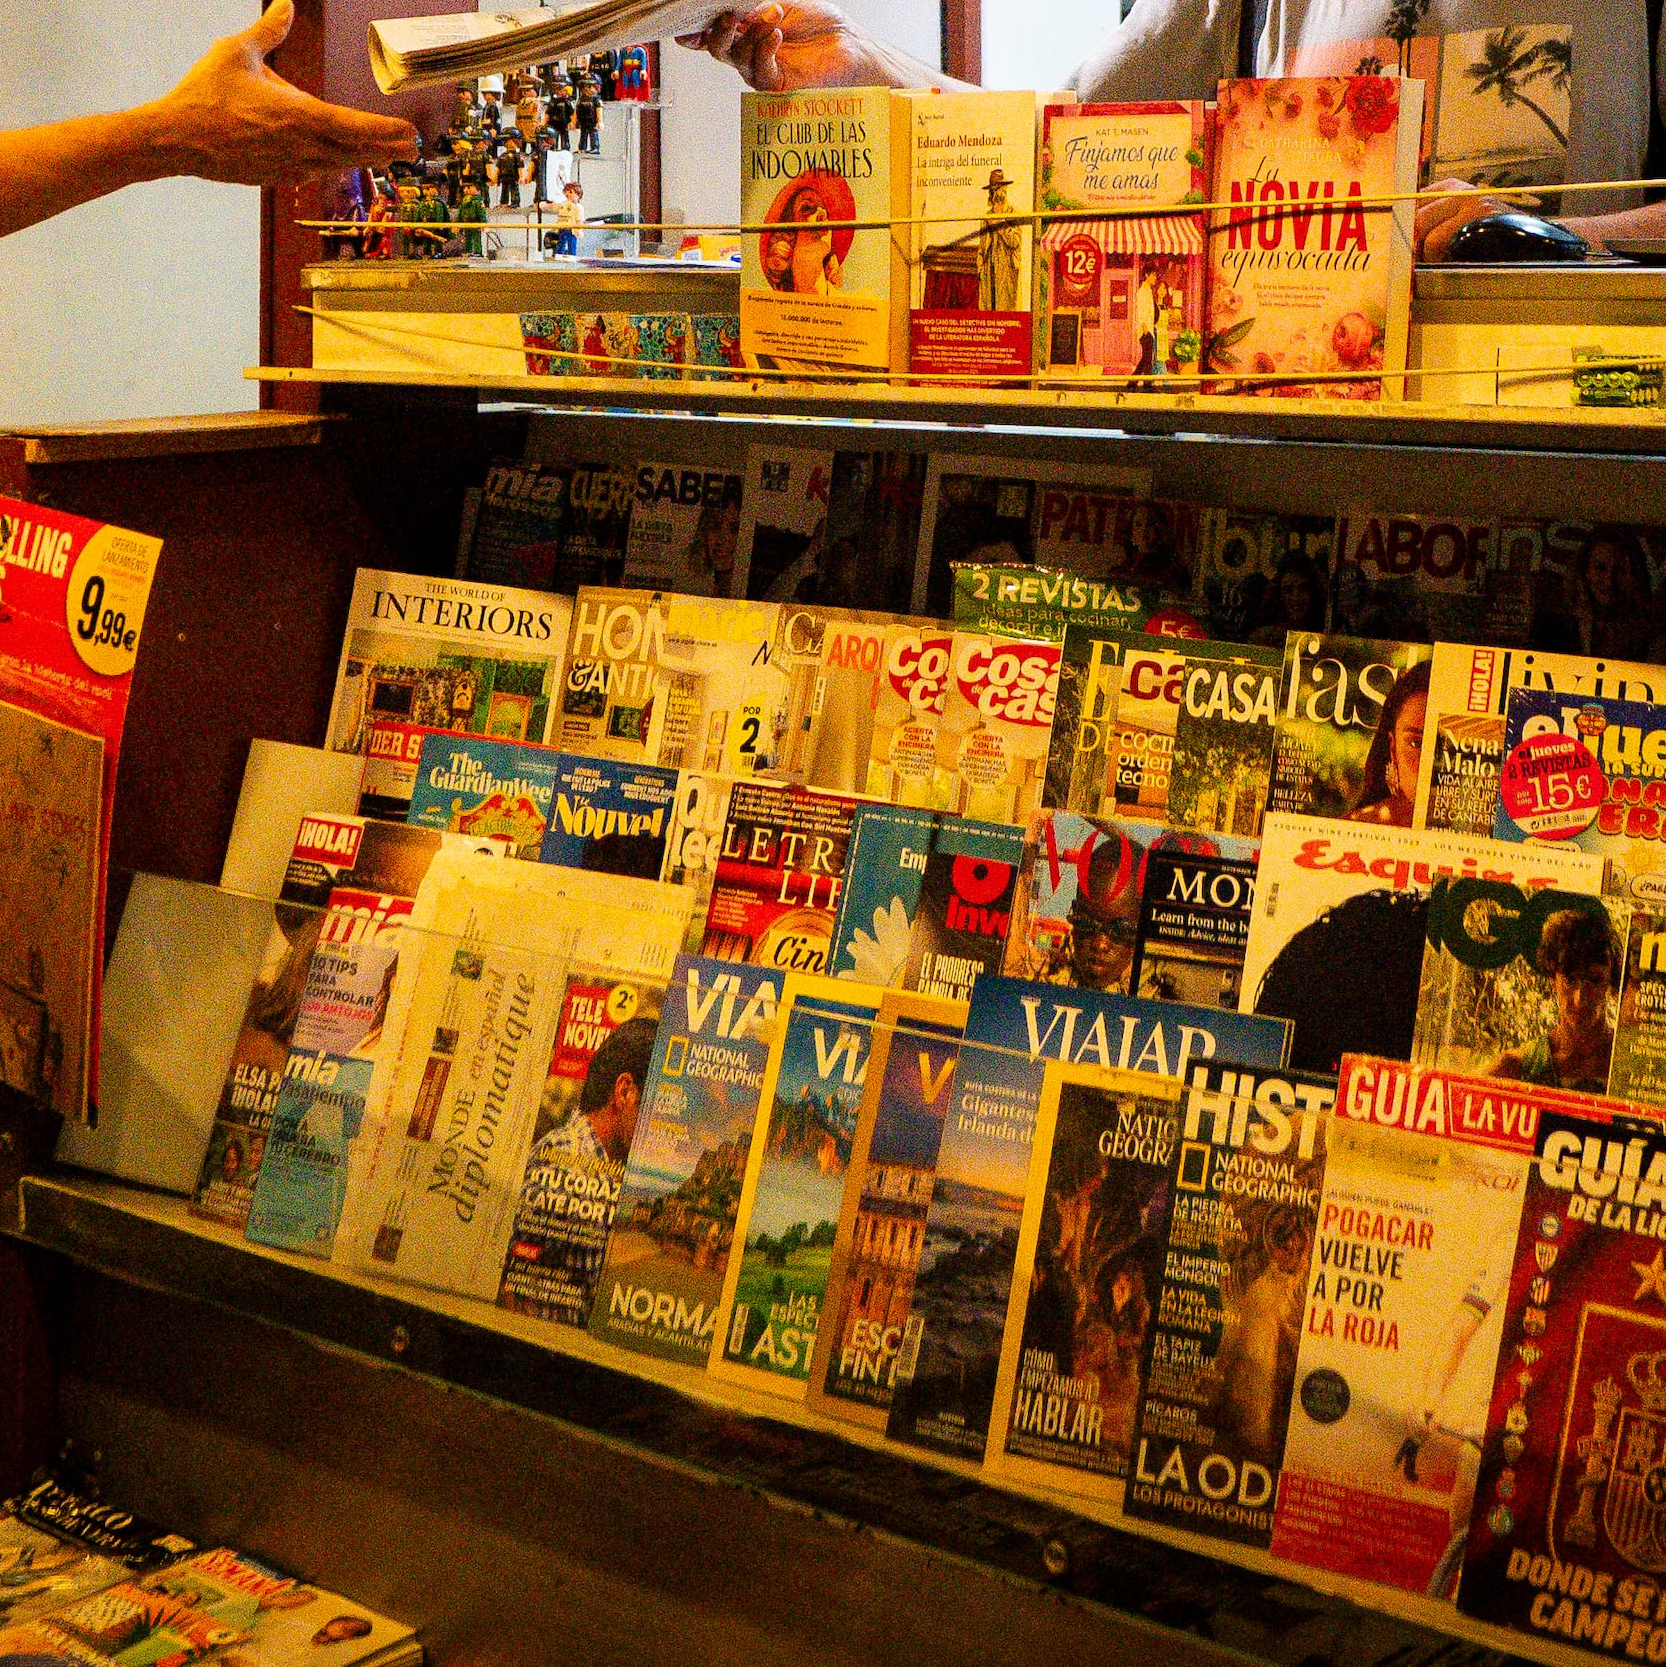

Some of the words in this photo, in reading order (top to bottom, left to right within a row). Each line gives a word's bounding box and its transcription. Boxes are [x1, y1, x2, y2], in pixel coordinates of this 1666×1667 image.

[757, 123, 771, 145] EL
[776, 124, 812, 144] CLUB
[817, 122, 835, 143] DE
[840, 121, 866, 143] LAS
[917, 136, 956, 149] Eduardo
[958, 134, 1002, 147] Mendoza
[751, 147, 873, 180] INDOMABLES
[957, 155, 969, 167] del
[971, 153, 1002, 166] funeral
[1064, 136, 1145, 172] Finjamos
[1147, 146, 1178, 170] que
[1082, 175, 1111, 191] me
[1114, 170, 1159, 191] amas
[1228, 181, 1369, 252] NOVIA
[1221, 246, 1372, 288] equivocada
[426, 582, 451, 595] THE
[452, 586, 485, 601] WORLD
[487, 591, 506, 602] OF
[972, 573, 990, 601] 2
[997, 573, 1142, 613] REVISTAS
[77, 575, 136, 653] 9,99€
[371, 591, 554, 642] INTERIORS
[1027, 609, 1065, 627] para
[1069, 610, 1132, 632] cocinar,
[1467, 649, 1495, 713] ¡HOLA!
[1185, 667, 1277, 727] CASA
[370, 731, 402, 758] DER
[740, 718, 761, 754] 2
[1448, 730, 1499, 756] Nena
[449, 751, 483, 774] The
[1115, 765, 1169, 790] tecno
[1442, 753, 1496, 780] Malo
[1521, 753, 1592, 775] REVISTAS
[1438, 773, 1461, 788] VIDA
[550, 793, 664, 840] Nouvel
[1434, 808, 1447, 820] DE
[1435, 797, 1451, 809] EN
[1452, 799, 1468, 812] SU
[298, 819, 359, 856] ¡HOLA!
[1151, 907, 1185, 926] Learn
[1187, 913, 1215, 931] from
[1217, 918, 1237, 933] the
[329, 958, 358, 976] TIPS
[306, 986, 374, 1007] CONTROLAR
[571, 994, 606, 1025] TELE
[1019, 995, 1217, 1080] VIAJAR
[284, 1050, 341, 1086] mia
[690, 1043, 750, 1068] NATIONAL
[685, 1060, 764, 1091] GEOGRAPHIC
[447, 970, 537, 1226] diplomatique
[1344, 1058, 1447, 1137] GUÍA
[958, 1113, 1017, 1143] Irlanda
[1215, 1152, 1297, 1183] NATIONAL
[526, 1191, 568, 1216] LATE
[570, 1199, 605, 1223] POR
[1174, 1194, 1190, 1208] LA
[1192, 1195, 1236, 1214] PIEDRA
[1210, 1173, 1320, 1212] GEOGRAPHIC
[1172, 1207, 1188, 1221] DE
[1322, 1203, 1436, 1252] POGACAR
[1566, 1195, 1599, 1226] DE
[1599, 1200, 1633, 1231] LA
[1180, 1255, 1232, 1275] IMPERIO
[1319, 1236, 1407, 1281] VUELVE
[1164, 1267, 1220, 1288] MONGOL
[1311, 1275, 1328, 1300] A
[1334, 1278, 1386, 1313] POR
[1307, 1305, 1335, 1337] LA
[1342, 1315, 1402, 1352] ROJA
[1023, 1346, 1054, 1371] CÓMO
[1013, 1389, 1105, 1447] HABLAR
[1135, 1436, 1190, 1494] LA
[1198, 1453, 1274, 1508] OD
[1505, 1546, 1614, 1609] DONDE
[1612, 1575, 1661, 1617] SE
